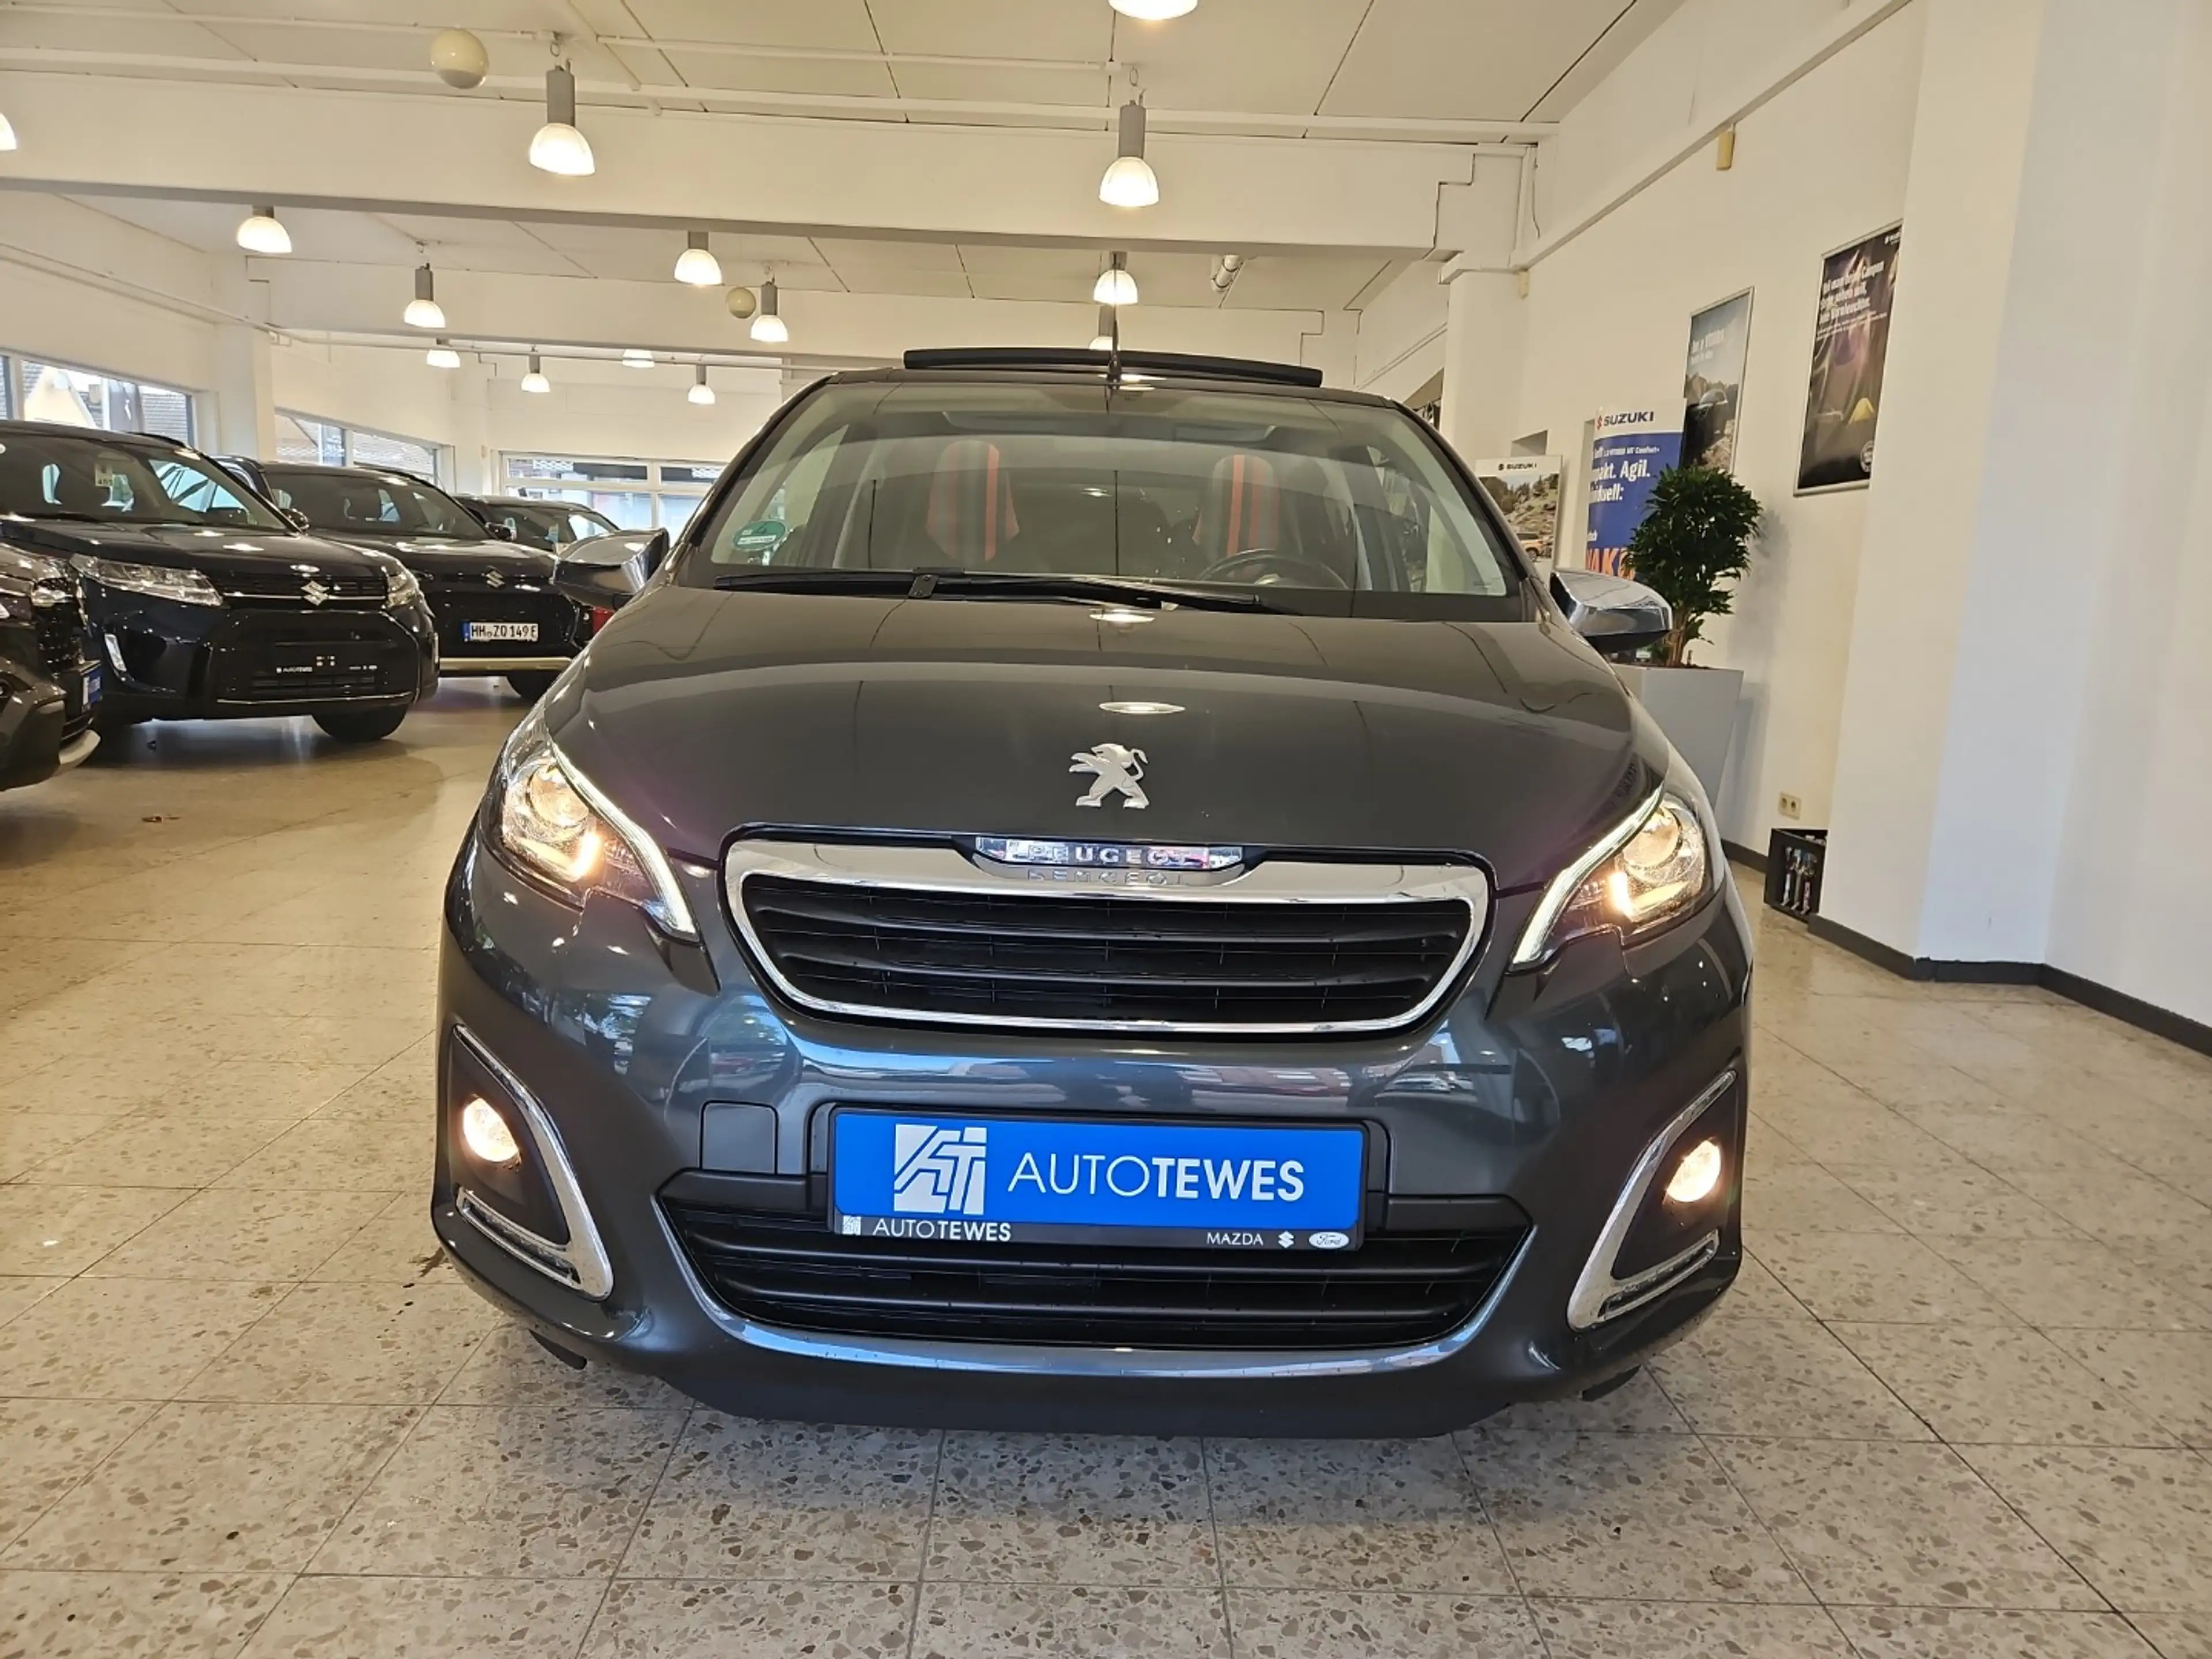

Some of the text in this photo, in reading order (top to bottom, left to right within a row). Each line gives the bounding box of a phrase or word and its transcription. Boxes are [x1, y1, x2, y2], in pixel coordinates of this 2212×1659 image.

[1604, 411, 1654, 426] SUZUKI
[1620, 459, 1651, 482] Agil.
[1007, 1152, 1304, 1202] AUTOTEWES
[1206, 1232, 1264, 1245] MAZDA
